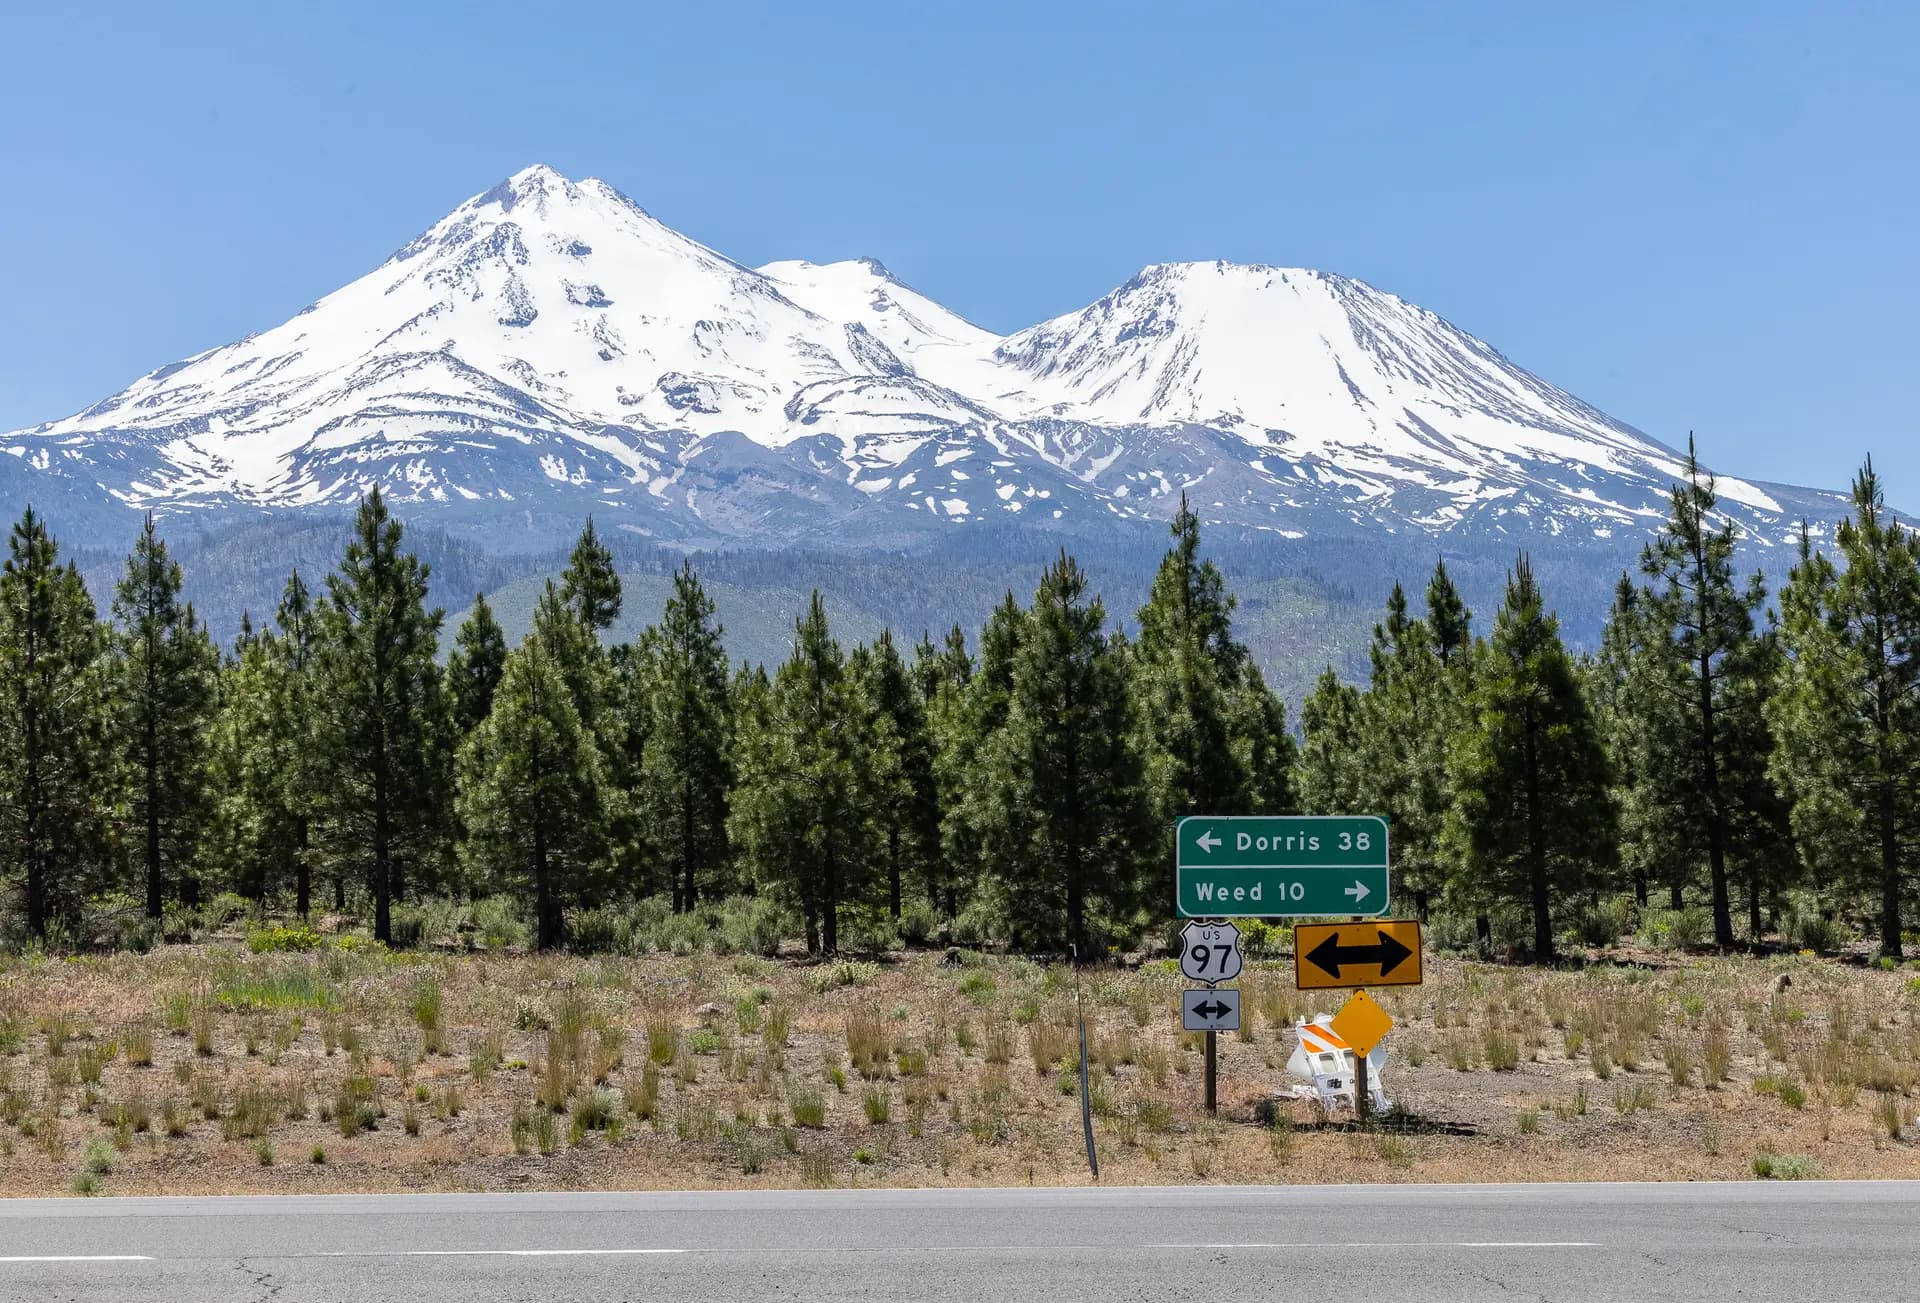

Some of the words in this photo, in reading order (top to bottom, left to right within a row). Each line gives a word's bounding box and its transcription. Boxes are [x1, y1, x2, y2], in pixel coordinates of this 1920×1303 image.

[1236, 831, 1321, 851] Dorris
[1338, 832, 1371, 851] 38
[1195, 882, 1263, 901] Weed
[1278, 882, 1304, 901] 10
[1202, 930, 1221, 941] US
[1190, 944, 1232, 974] 97
